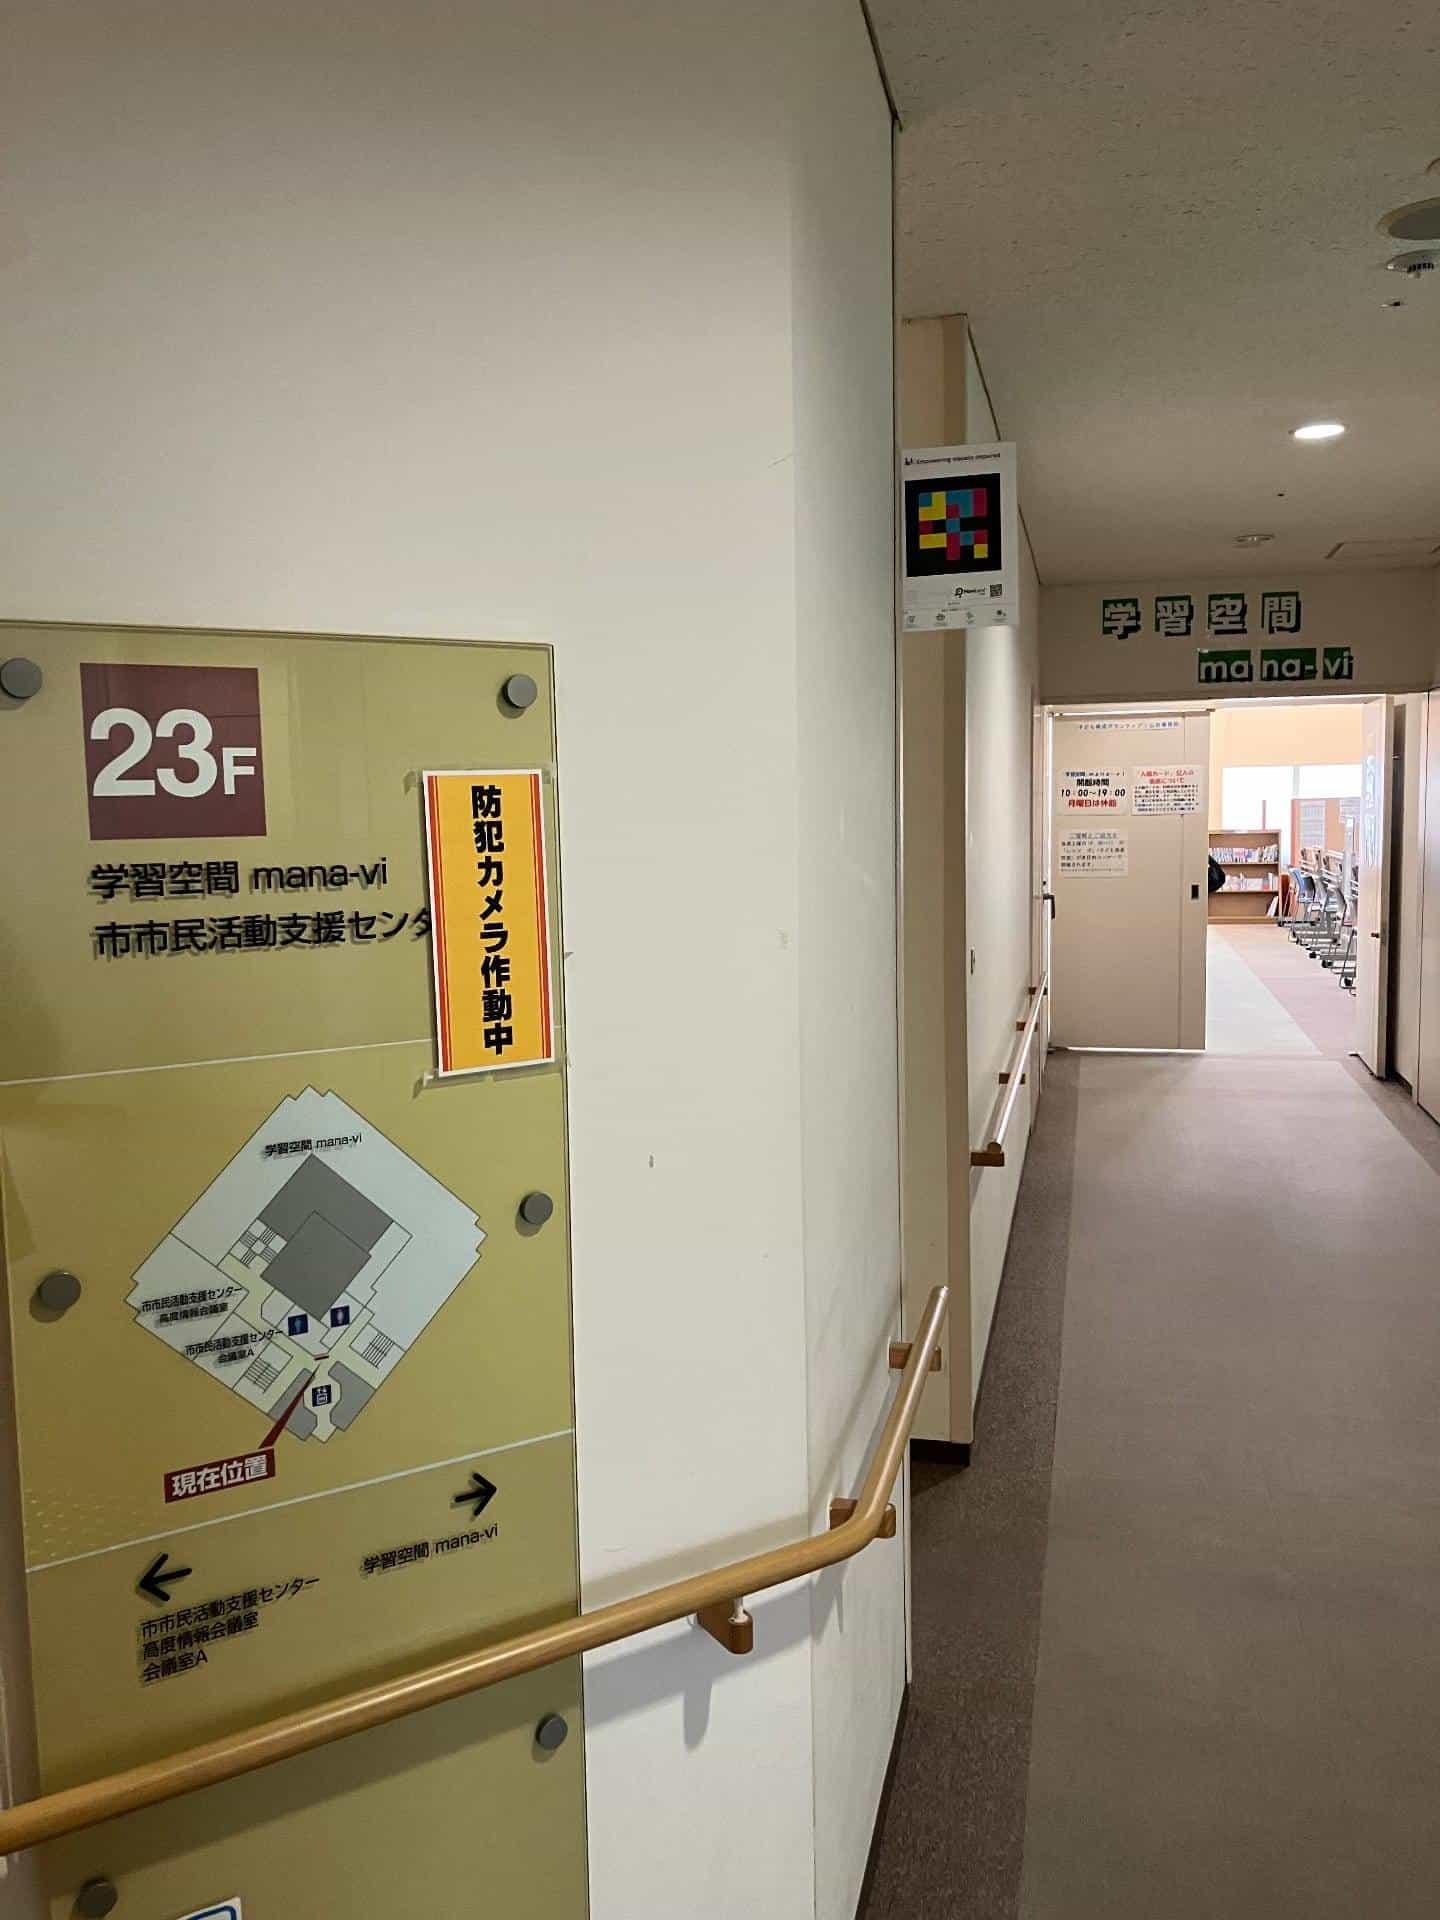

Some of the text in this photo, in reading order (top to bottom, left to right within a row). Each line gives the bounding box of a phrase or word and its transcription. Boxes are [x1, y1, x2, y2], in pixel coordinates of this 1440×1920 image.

[1102, 591, 1303, 639] 学習空間
[91, 857, 389, 900] 学習空間 mana-vi
[471, 785, 514, 1056] 防犯カメラ作動中
[264, 1133, 363, 1157] 学習空間 mana-vi
[142, 1286, 243, 1312] 市市民活動支援センター
[171, 1453, 269, 1498] 現在位置
[363, 1523, 498, 1575] 学習空間 mana-vi
[141, 1575, 320, 1638] 市市民活動支援センター
[142, 1611, 259, 1660] 高度情報会議室
[143, 1649, 207, 1683] 会議室A
